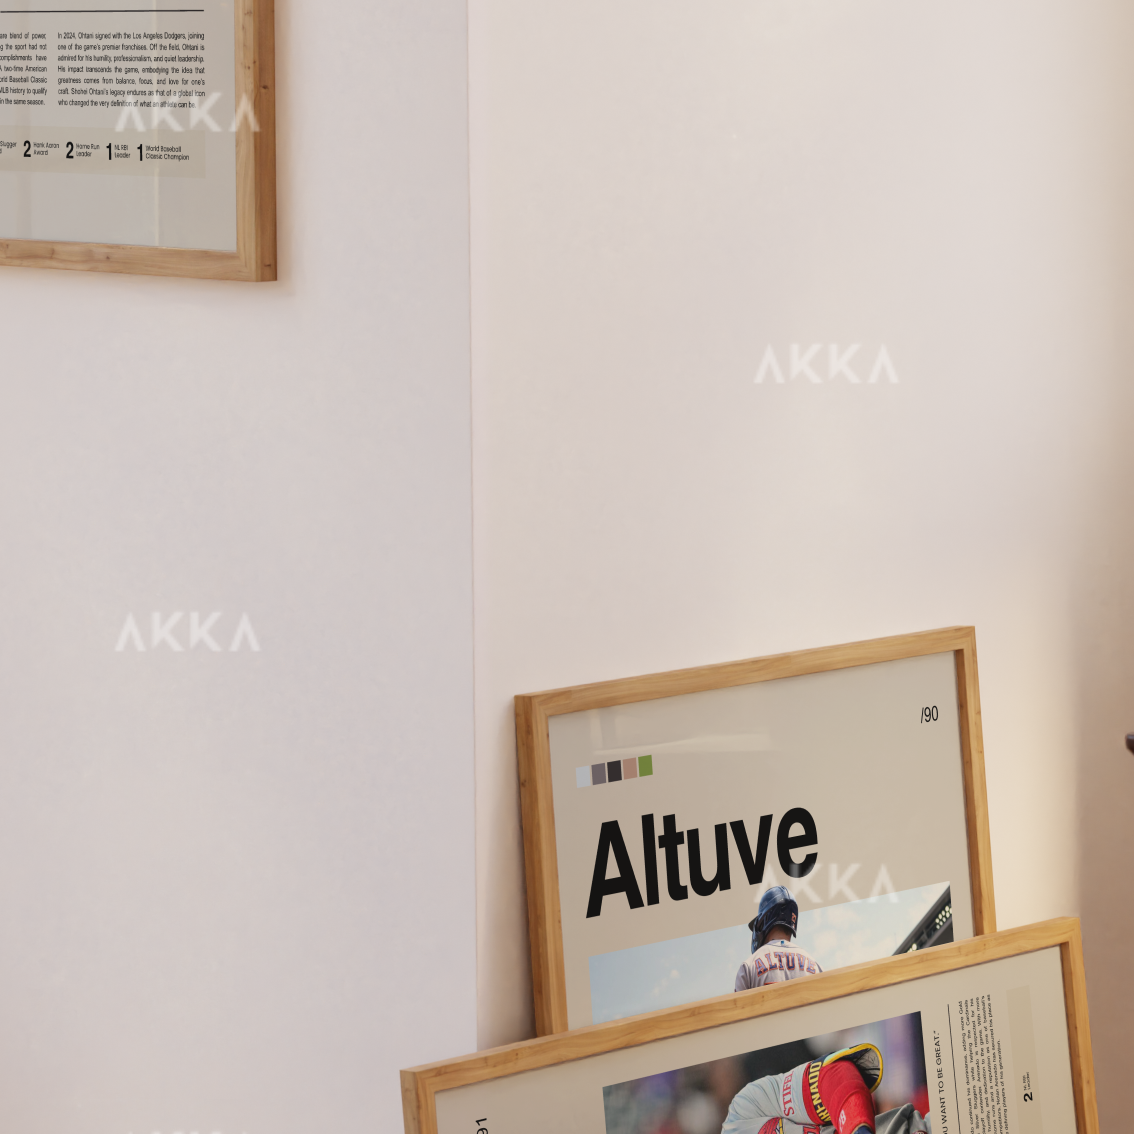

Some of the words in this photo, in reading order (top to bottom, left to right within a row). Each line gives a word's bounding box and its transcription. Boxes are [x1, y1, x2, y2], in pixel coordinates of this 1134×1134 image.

[24, 140, 31, 157] 2
[66, 141, 74, 159] 2
[106, 143, 112, 160] 1
[137, 144, 143, 161] 1
[920, 706, 940, 725] /90
[585, 806, 819, 919] Altuve
[755, 951, 816, 977] ALTUVE
[937, 1068, 944, 1078] BE
[783, 1070, 794, 1116] STIFEL
[938, 1081, 944, 1094] TO
[1024, 1092, 1033, 1102] 2
[940, 1097, 948, 1124] WANT
